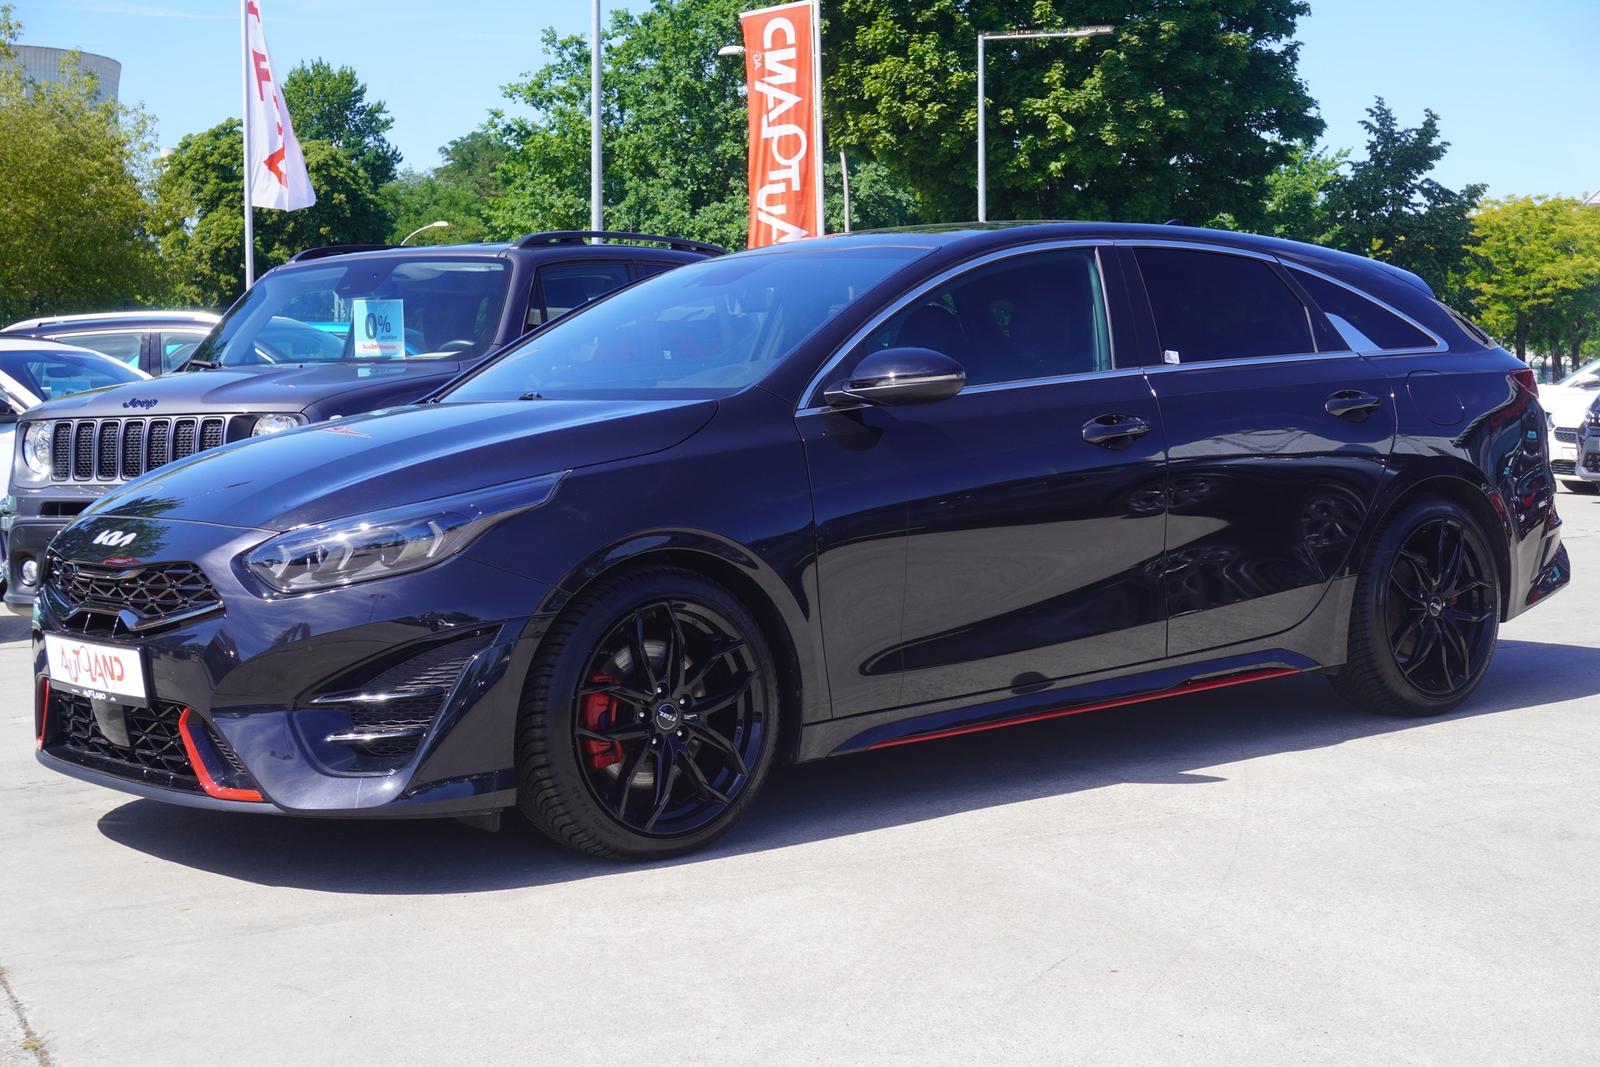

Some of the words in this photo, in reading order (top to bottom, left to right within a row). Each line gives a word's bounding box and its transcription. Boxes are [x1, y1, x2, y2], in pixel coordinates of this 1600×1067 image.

[365, 312, 391, 340] 0%
[123, 398, 158, 410] Jeep
[61, 644, 125, 689] AUTOLAND
